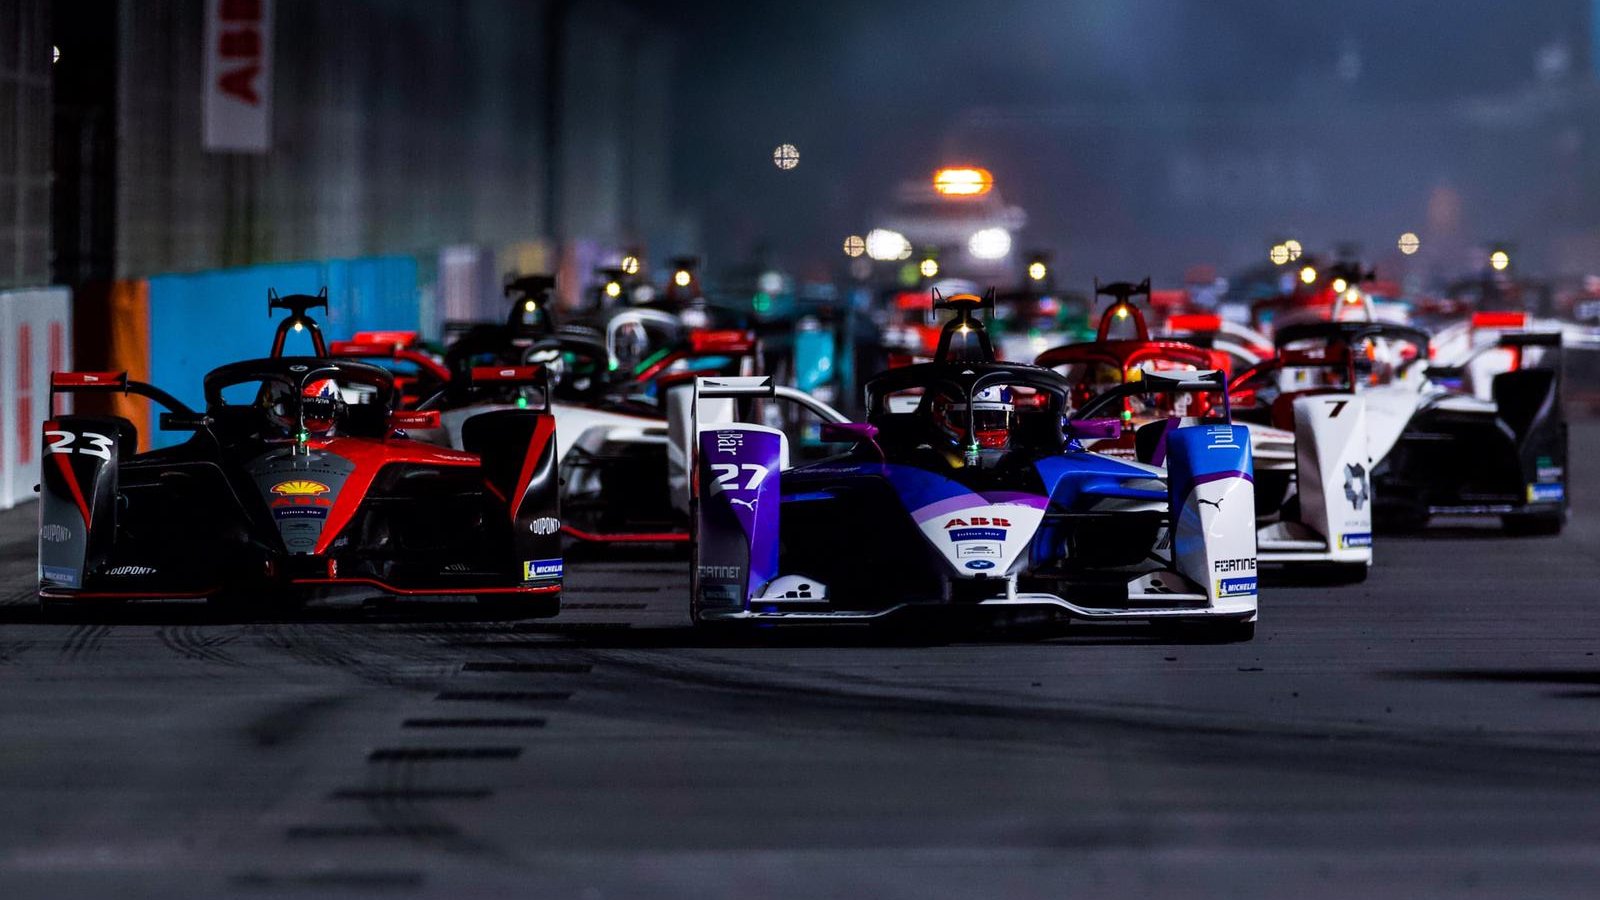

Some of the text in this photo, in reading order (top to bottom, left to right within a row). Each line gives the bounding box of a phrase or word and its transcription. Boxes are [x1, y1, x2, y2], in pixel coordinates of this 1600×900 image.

[1325, 400, 1350, 417] 7
[44, 430, 114, 461] 23
[709, 463, 769, 497] 27
[529, 516, 561, 535] DUPONT
[943, 517, 1012, 529] ABB
[109, 565, 153, 576] DUPONT
